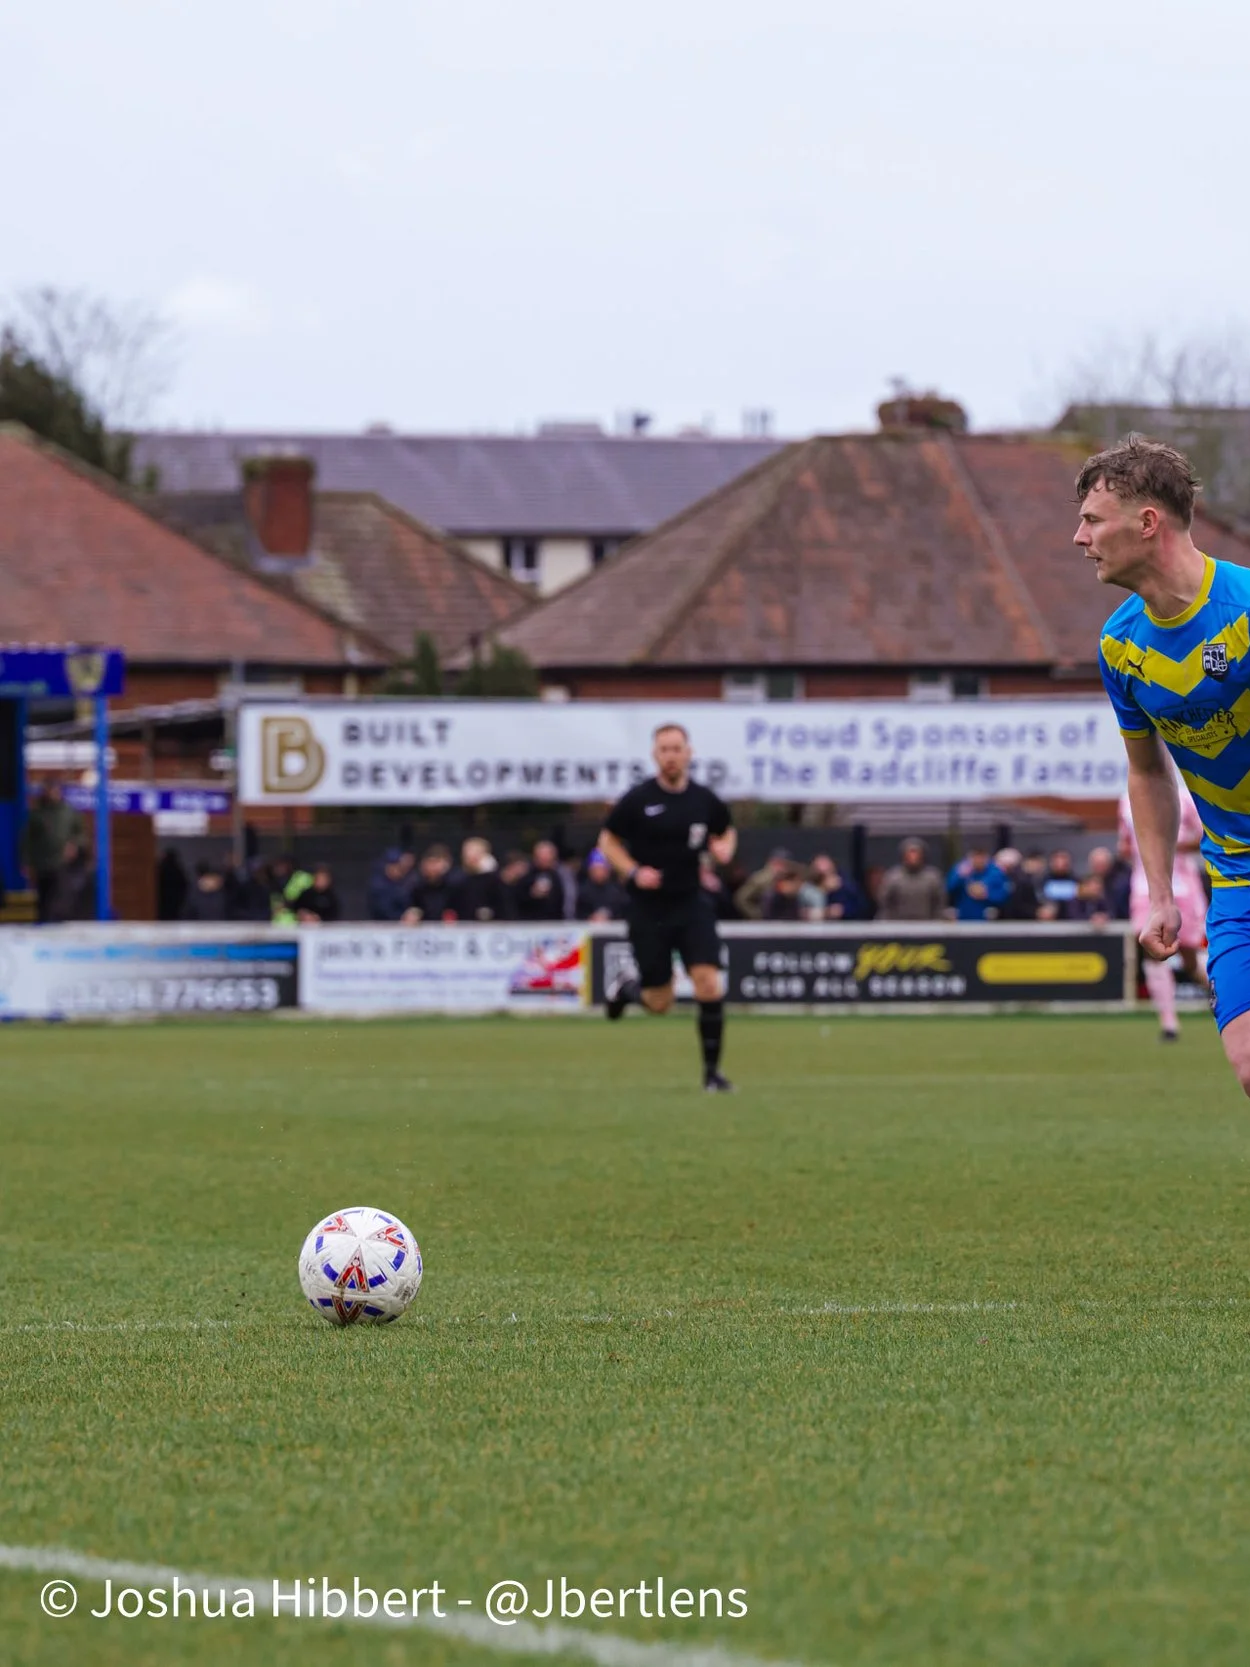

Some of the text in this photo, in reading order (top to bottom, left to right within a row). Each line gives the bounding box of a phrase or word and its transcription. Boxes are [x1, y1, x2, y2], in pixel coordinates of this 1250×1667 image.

[341, 719, 452, 748] BUILT
[745, 717, 1098, 753] Proud Sponsors of
[340, 760, 645, 788] DEVELOPMENTS
[751, 757, 815, 787] The
[829, 757, 1001, 787] Radcliffe
[753, 951, 853, 974] FOLLOW
[740, 975, 967, 998] CLUB ALL SEASON
